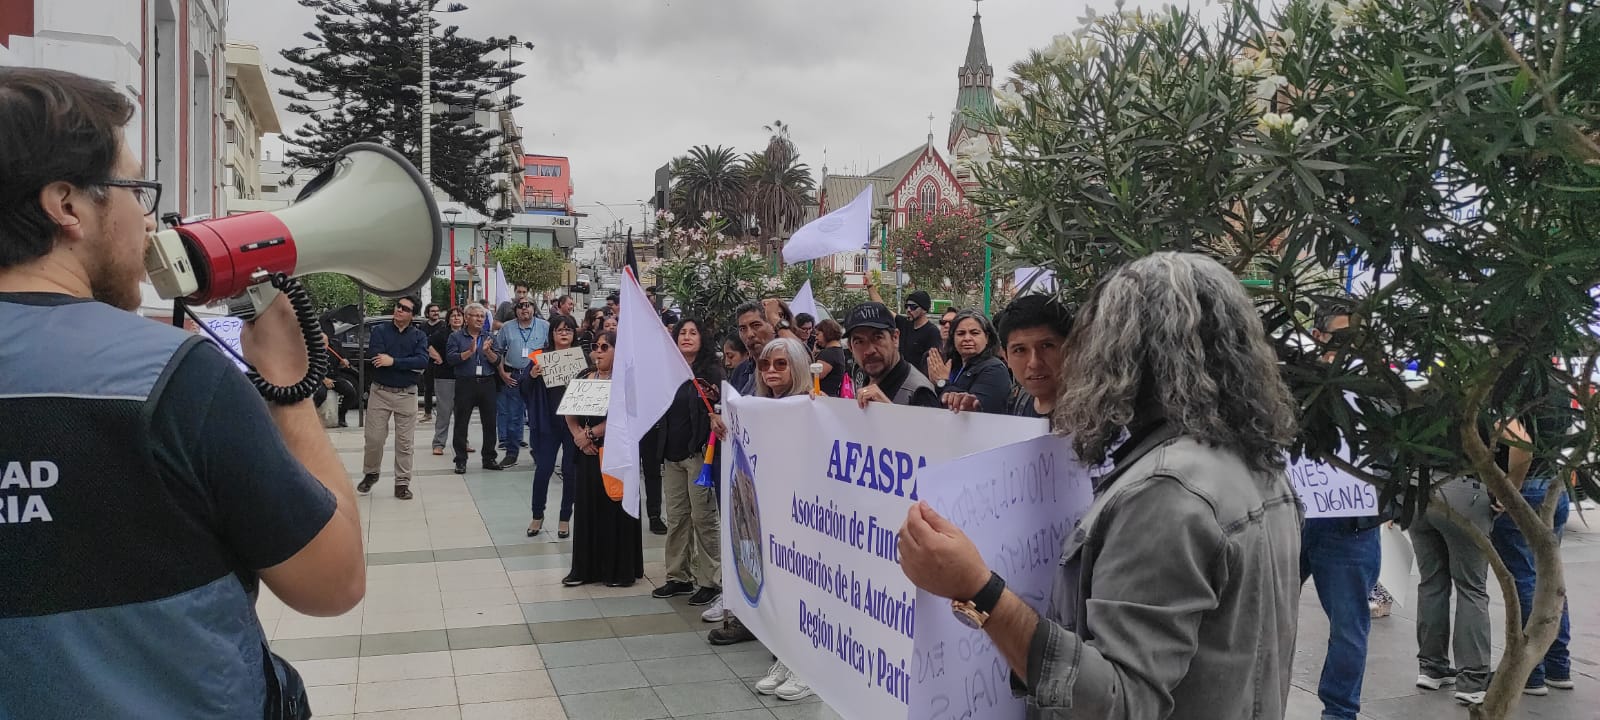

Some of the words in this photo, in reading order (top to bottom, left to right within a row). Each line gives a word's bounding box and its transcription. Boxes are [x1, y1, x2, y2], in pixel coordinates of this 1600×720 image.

[543, 352, 560, 364] NO
[574, 382, 592, 393] NO
[0, 460, 59, 489] AD
[1286, 463, 1329, 489] NES
[1313, 483, 1375, 513] DIGNAS
[791, 490, 846, 543] Asociación
[849, 510, 865, 550] de
[867, 515, 901, 565] Func
[769, 533, 833, 594] Funcionarios
[835, 564, 848, 603] de
[851, 570, 861, 611] la
[863, 577, 916, 640] Autorid
[799, 599, 834, 653] Región
[836, 623, 865, 675] Arica
[868, 649, 875, 688] y
